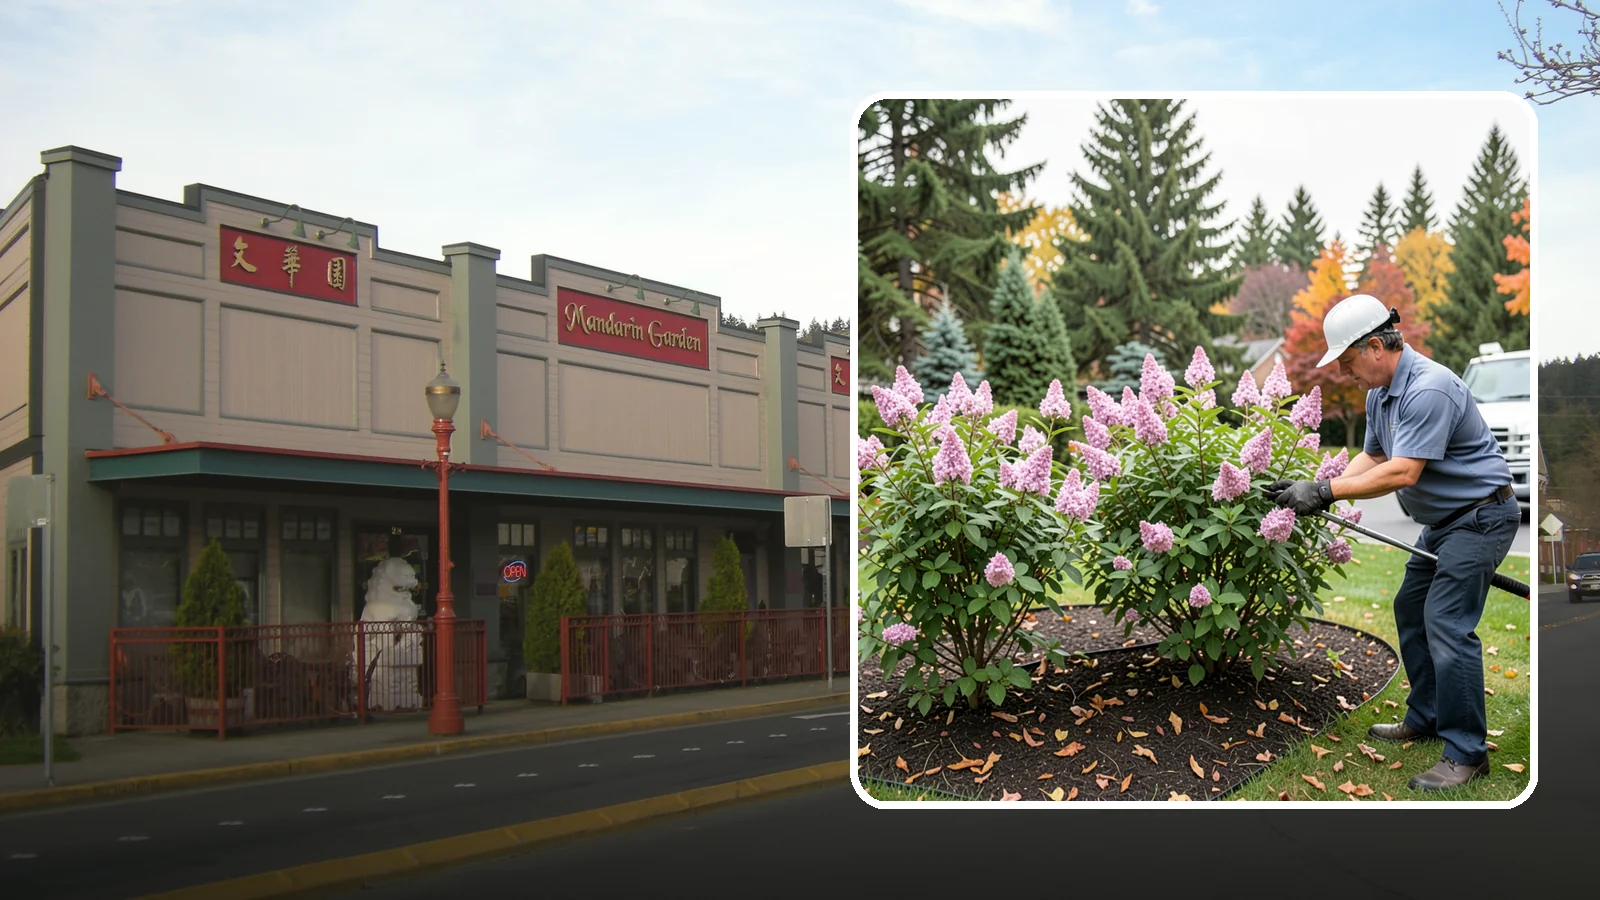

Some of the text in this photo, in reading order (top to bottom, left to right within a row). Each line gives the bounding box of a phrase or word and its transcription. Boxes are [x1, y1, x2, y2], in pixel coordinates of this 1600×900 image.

[230, 235, 346, 291] 文華園
[564, 302, 702, 352] Mandarin Garden
[503, 565, 527, 578] OPEN
